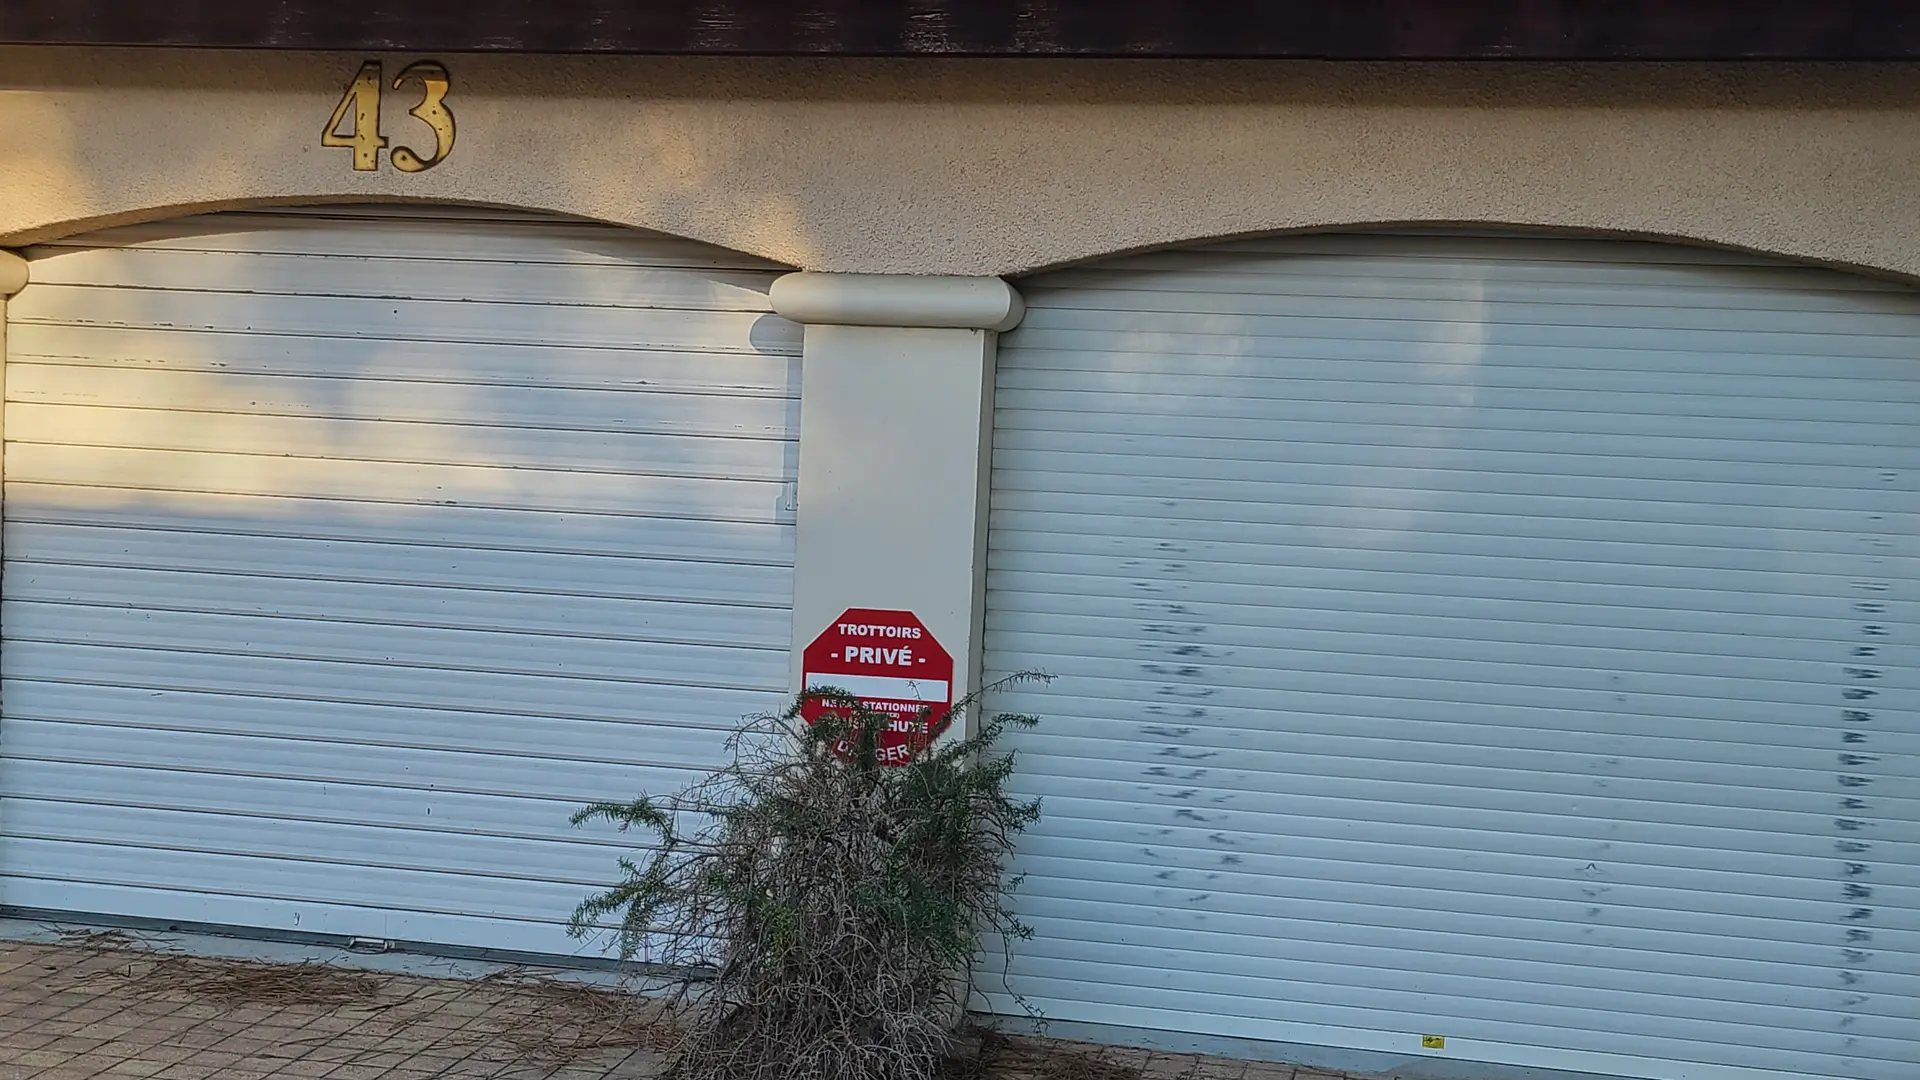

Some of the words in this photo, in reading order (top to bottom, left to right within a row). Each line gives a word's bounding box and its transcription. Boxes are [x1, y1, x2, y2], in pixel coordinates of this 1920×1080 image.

[321, 60, 457, 173] 43
[838, 623, 922, 639] TROTTOIRS
[845, 645, 912, 666] PRIVÉ
[837, 740, 910, 761] DGER
